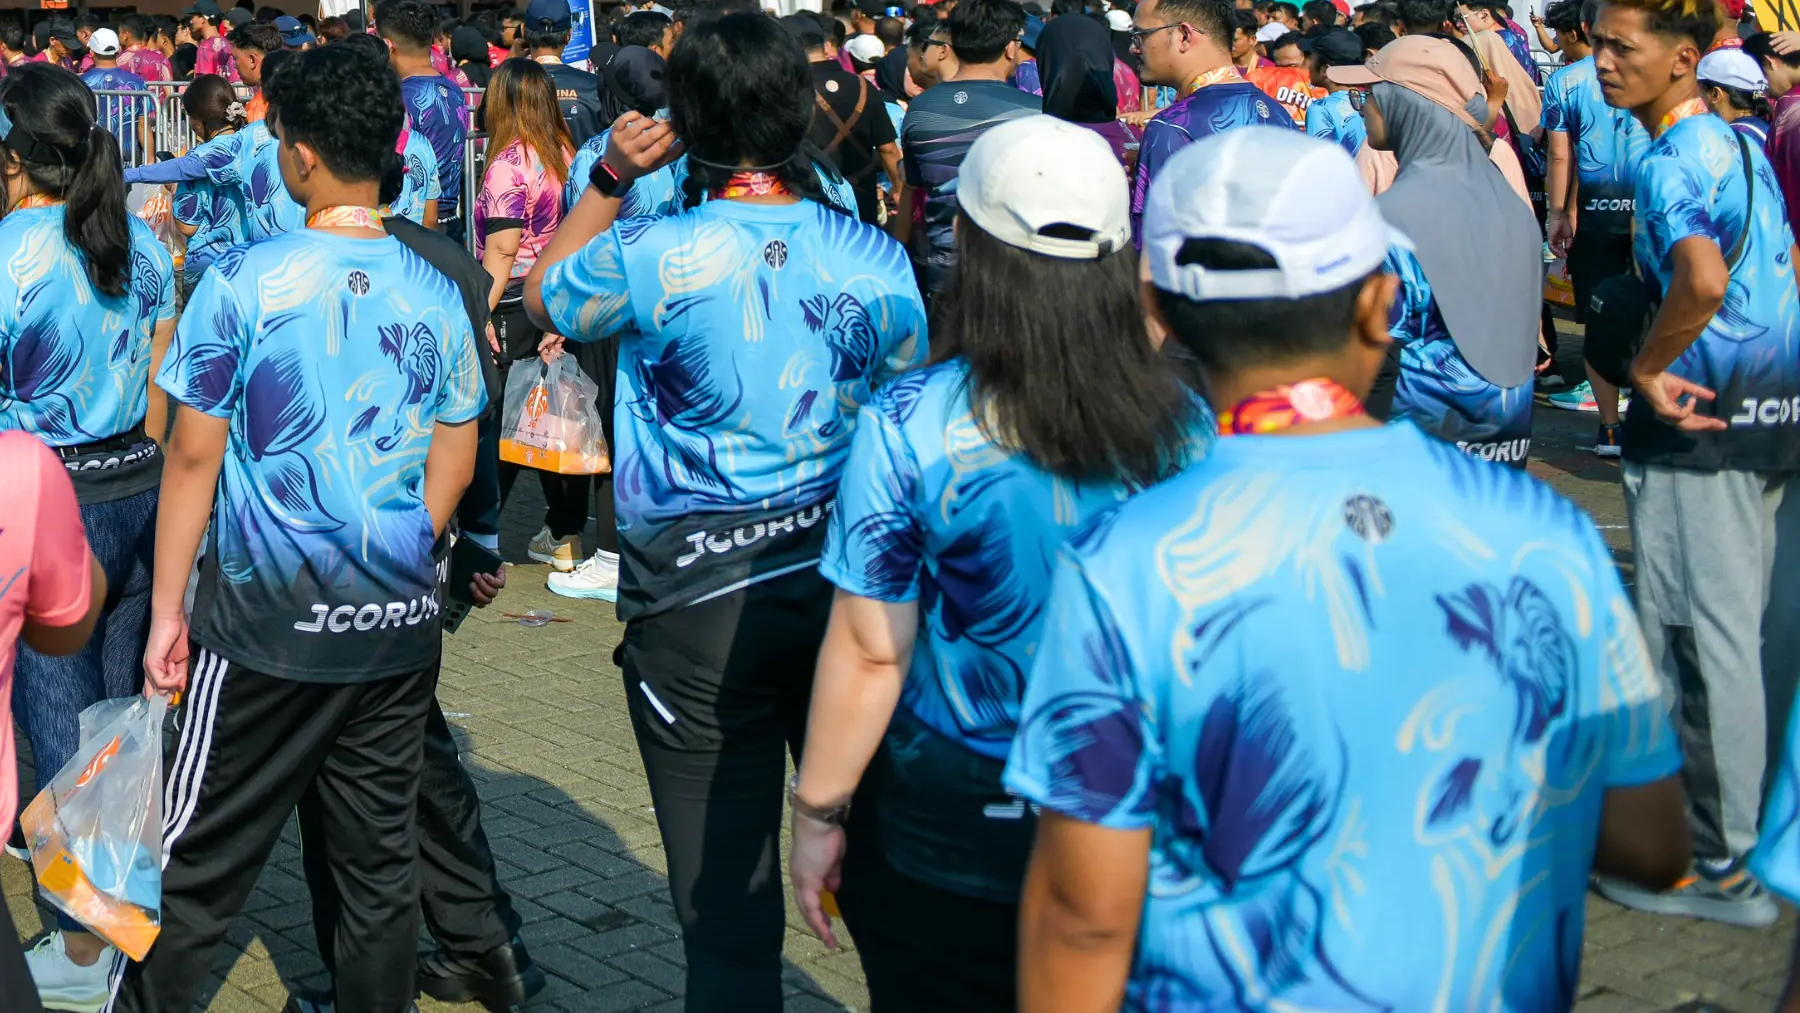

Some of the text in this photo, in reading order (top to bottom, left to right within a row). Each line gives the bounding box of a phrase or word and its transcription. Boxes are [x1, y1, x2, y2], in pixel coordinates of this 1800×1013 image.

[1276, 86, 1313, 108] OFFI
[1585, 199, 1636, 211] JCOR
[1731, 396, 1800, 424] JCO
[676, 499, 837, 568] JCORU
[294, 588, 440, 633] JCORUN
